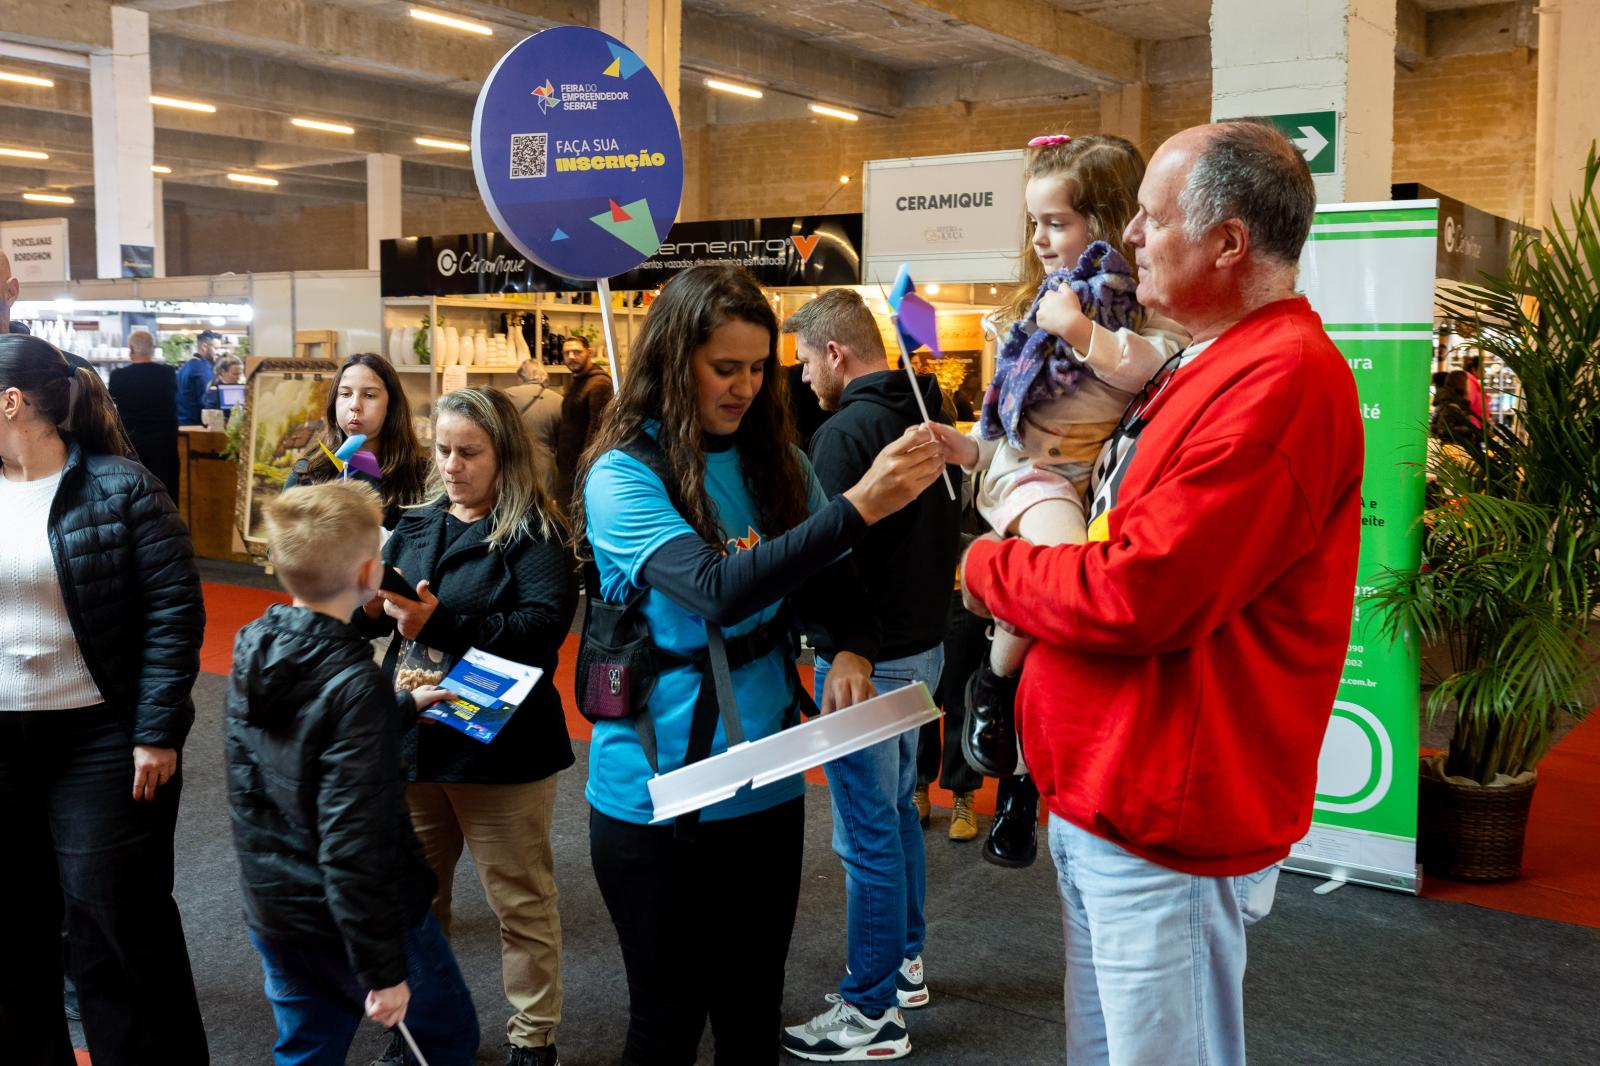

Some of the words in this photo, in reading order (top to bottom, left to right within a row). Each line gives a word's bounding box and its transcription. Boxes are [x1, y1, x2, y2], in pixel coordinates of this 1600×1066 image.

[560, 84, 584, 93] FEIRA
[585, 83, 597, 92] DO
[562, 92, 629, 101] EMPREENDEDOR
[563, 101, 598, 111] SEBRAE
[556, 139, 591, 156] FAÇA
[593, 138, 619, 152] SUA
[555, 149, 666, 172] INSCRIÇÃO
[896, 191, 993, 212] CERAMIQUE
[1361, 403, 1381, 419] té
